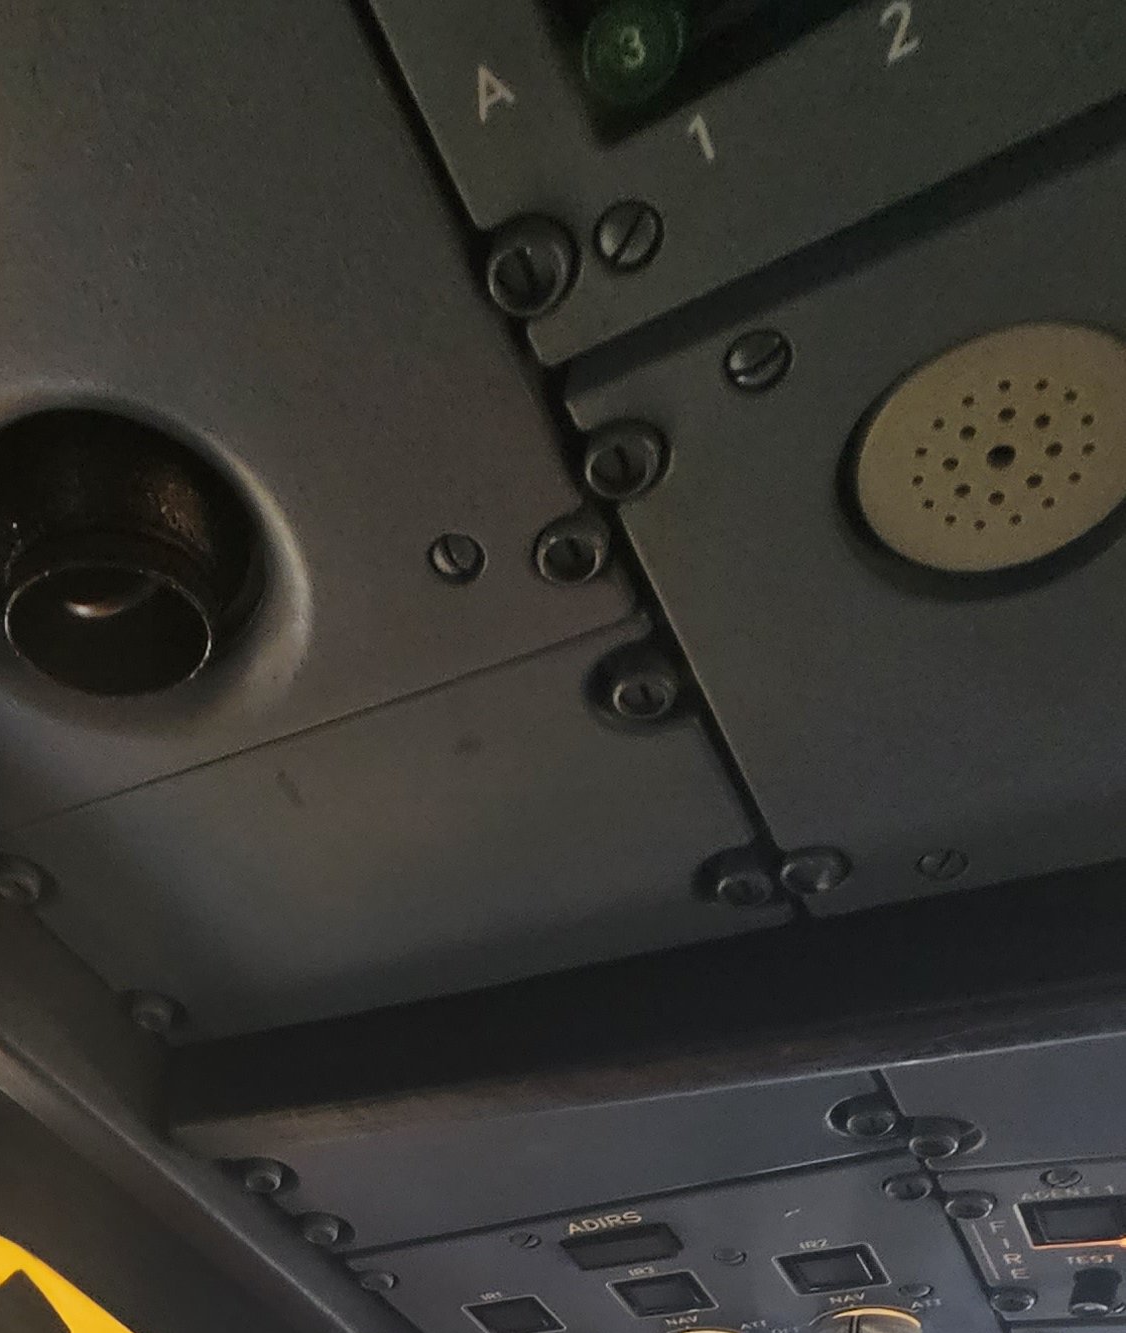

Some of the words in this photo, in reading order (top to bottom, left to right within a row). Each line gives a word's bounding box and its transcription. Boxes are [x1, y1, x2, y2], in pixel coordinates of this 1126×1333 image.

[880, 1, 921, 64] 2
[477, 63, 515, 124] A
[688, 113, 715, 162] 1
[567, 1211, 643, 1235] ADIRS
[989, 1220, 1030, 1279] FIRE
[1066, 1254, 1115, 1265] TEST
[829, 1292, 865, 1305] NAV
[664, 1316, 698, 1326] NAV
